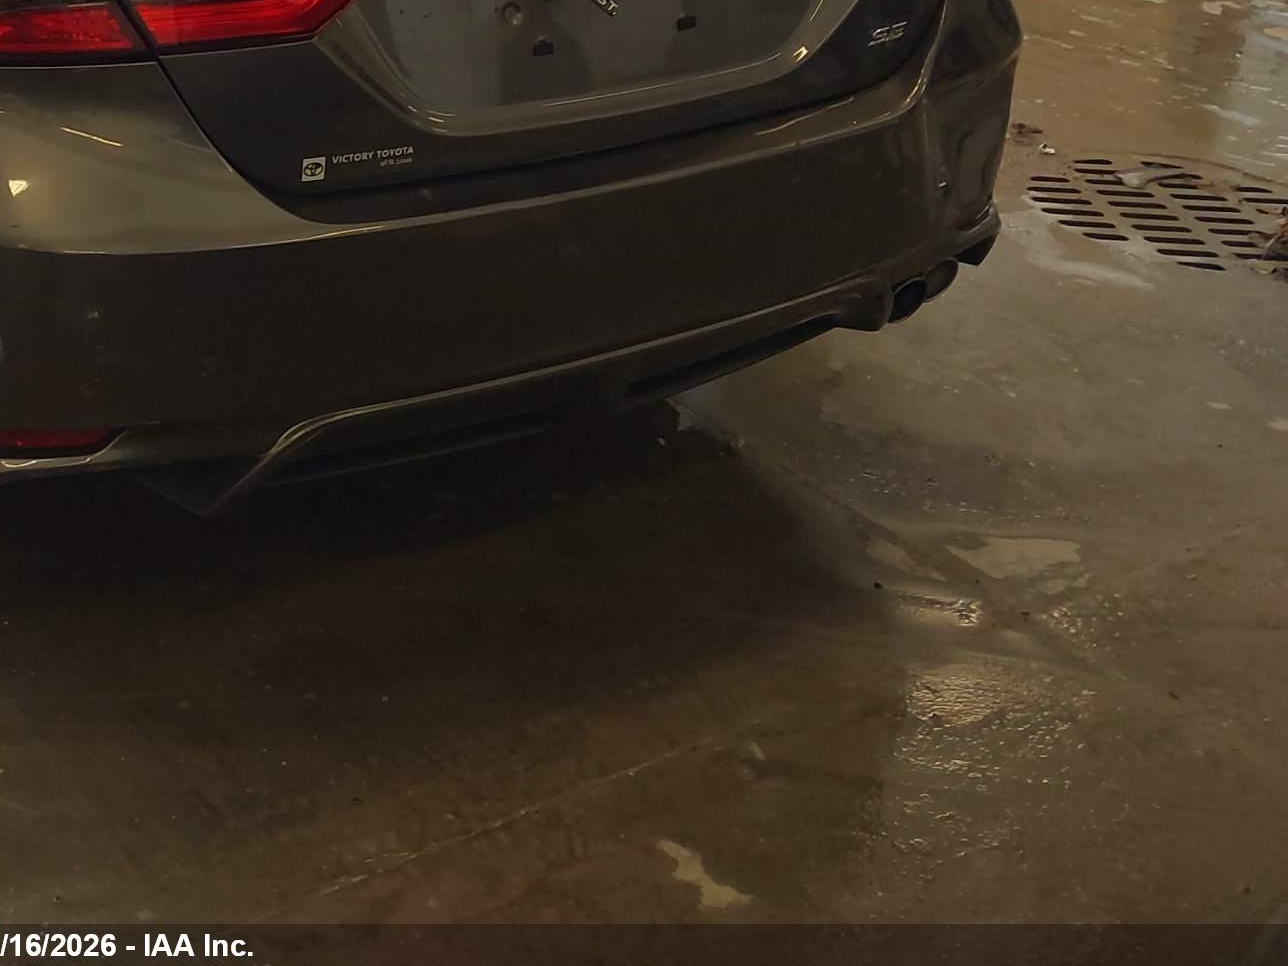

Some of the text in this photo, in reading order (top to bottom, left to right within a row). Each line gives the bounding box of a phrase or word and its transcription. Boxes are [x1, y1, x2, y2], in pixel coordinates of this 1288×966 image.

[868, 20, 909, 47] SE
[332, 146, 414, 164] VICTORY TOYOTA
